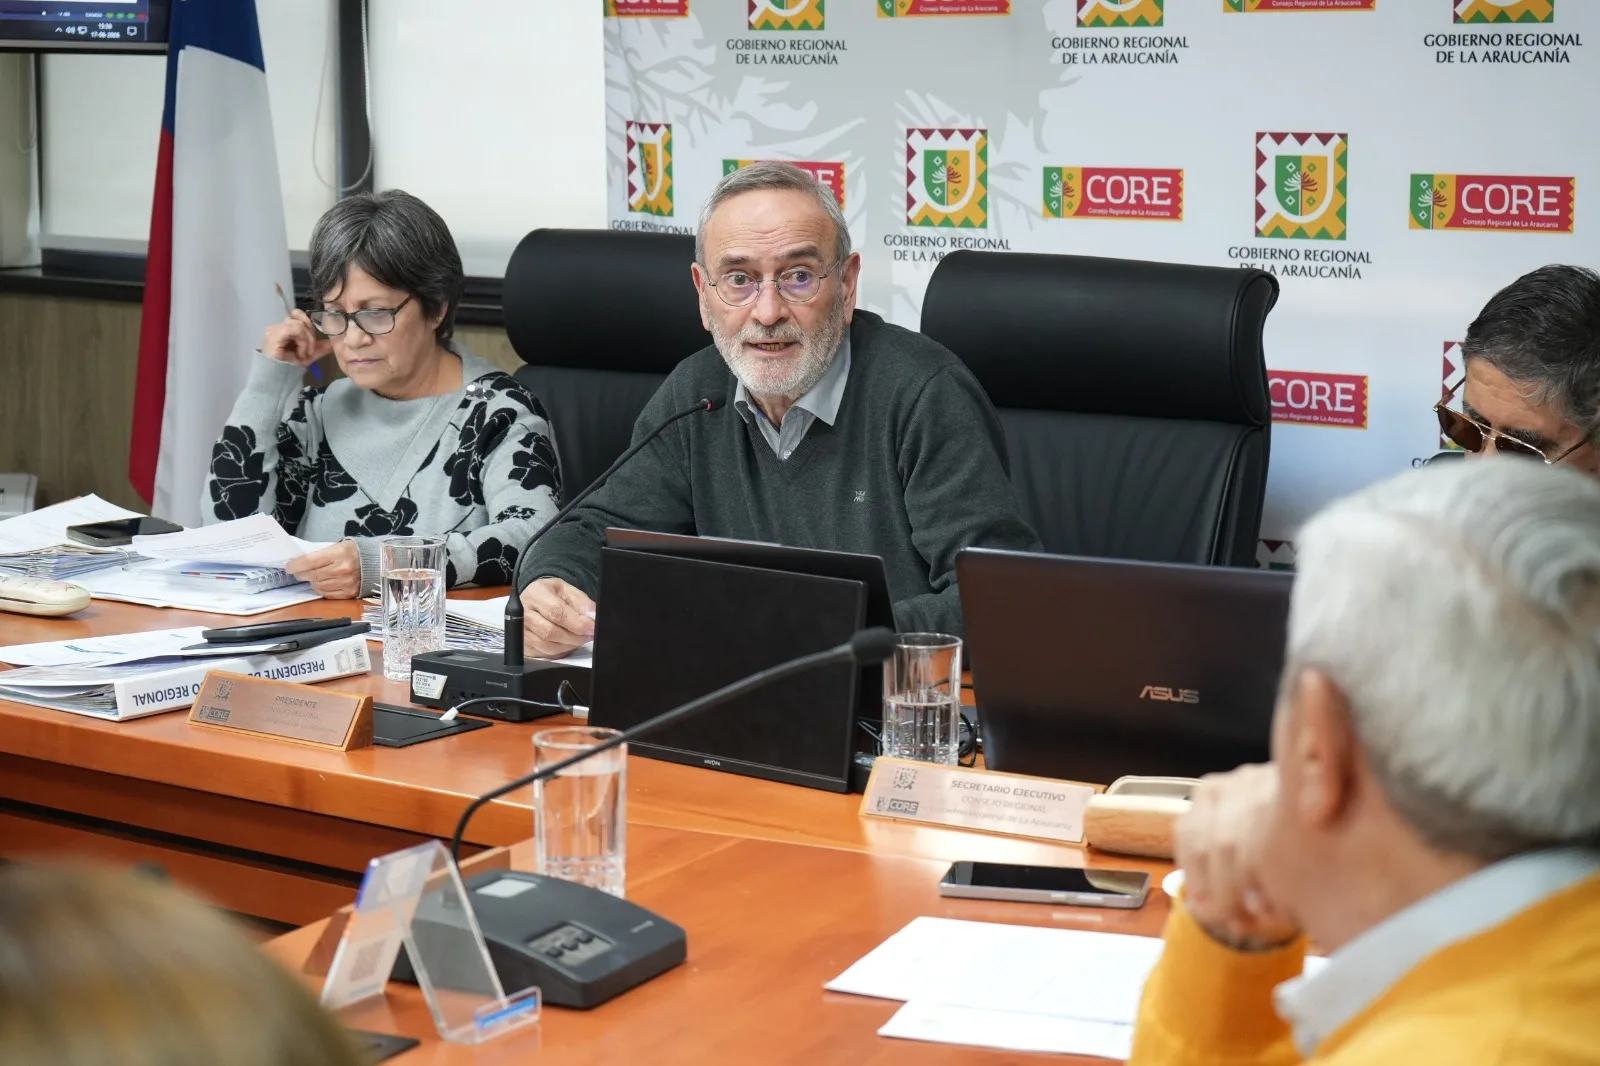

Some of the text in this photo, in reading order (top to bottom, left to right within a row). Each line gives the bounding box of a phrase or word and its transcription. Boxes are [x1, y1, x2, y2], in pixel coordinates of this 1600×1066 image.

[726, 39, 847, 50] GOBIERNO REGIONAL
[1051, 36, 1189, 49] GOBIERNO REGIONAL
[1424, 33, 1583, 47] GOBIERNO REGIONAL
[736, 52, 838, 65] DE LA ARAUCANÍA
[1062, 49, 1178, 64] DE LA ARAUCANÍA
[1436, 47, 1570, 63] DE LA ARAUCANÍA
[1086, 175, 1172, 205] CORE
[1461, 183, 1560, 216] CORE
[1463, 217, 1486, 226] Consejo
[1487, 219, 1511, 227] Regional
[884, 235, 1011, 250] GOBIERNO REGIONAL
[894, 250, 908, 261] DE
[912, 250, 926, 261] LA
[1228, 247, 1372, 264] GOBIERNO REGIONAL
[1281, 264, 1362, 279] ARAUCANÍA
[1269, 378, 1355, 412] CORE
[264, 660, 325, 679] PRESIDENTE
[132, 684, 189, 706] REGIONAL
[275, 695, 318, 708] PRESIDENTE
[1140, 685, 1199, 703] ASUS
[951, 780, 1066, 802] SECRETARIO EJECUTIVO
[891, 800, 918, 812] CORE
[961, 795, 1046, 813] CONSEJO REGIONAL
